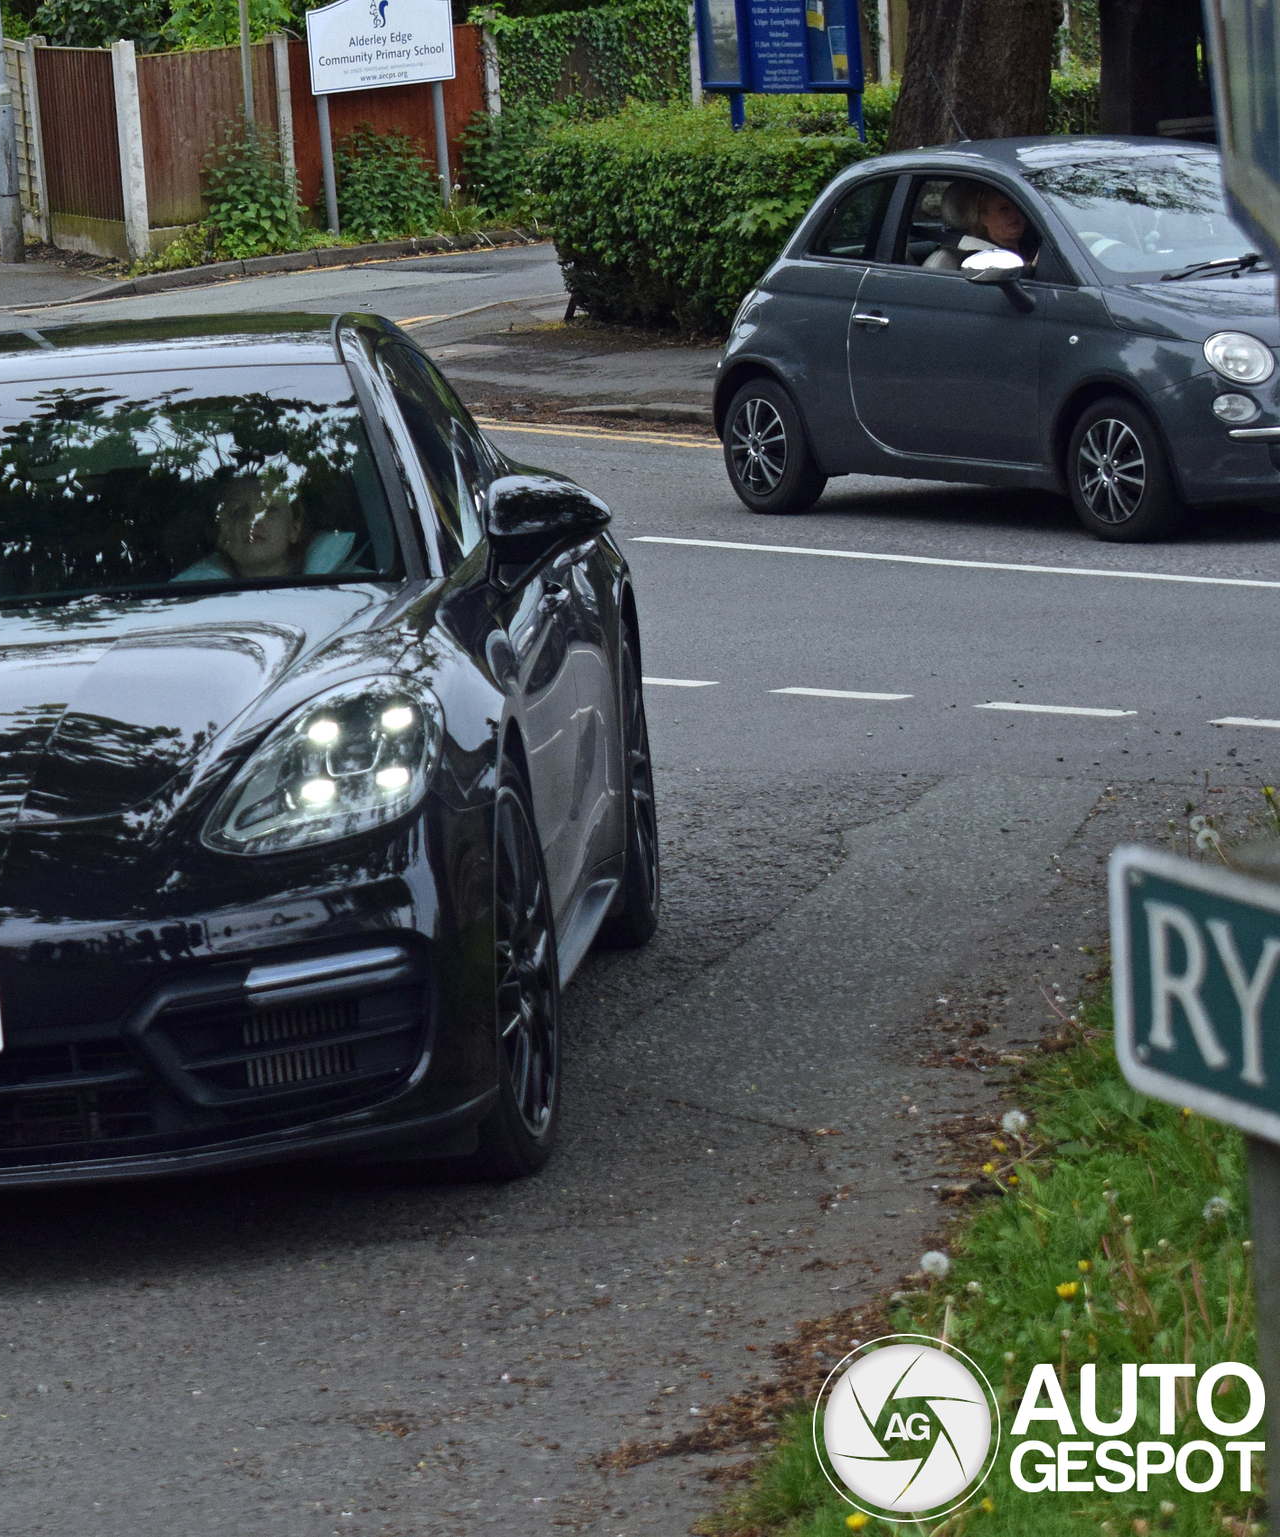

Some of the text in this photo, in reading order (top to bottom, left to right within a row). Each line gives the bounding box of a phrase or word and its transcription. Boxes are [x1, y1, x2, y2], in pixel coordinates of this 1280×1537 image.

[349, 32, 412, 47] Alderley Edge
[319, 43, 445, 67] Community Primary School
